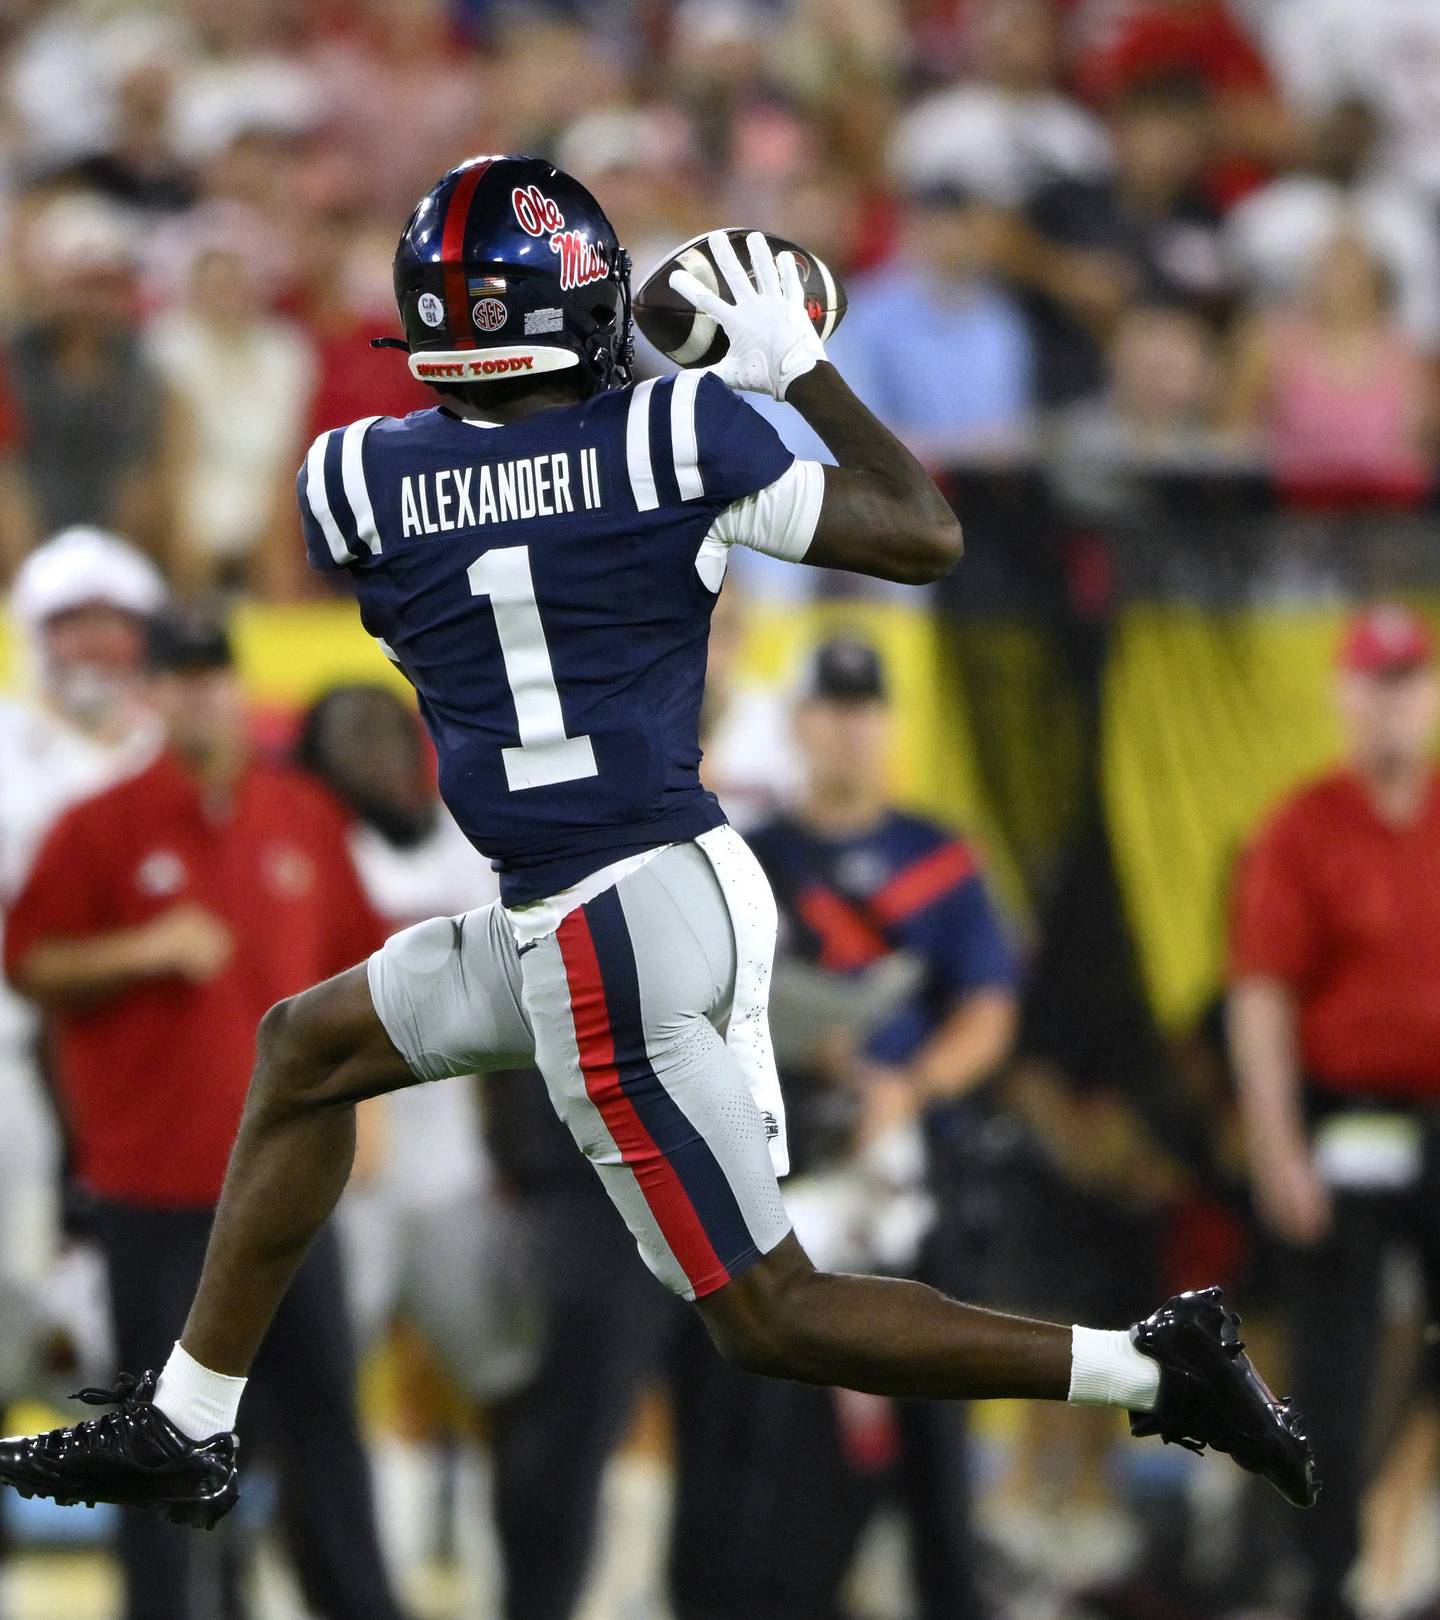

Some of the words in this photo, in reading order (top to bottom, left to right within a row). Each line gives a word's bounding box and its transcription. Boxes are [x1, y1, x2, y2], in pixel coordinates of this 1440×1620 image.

[512, 185, 565, 237] Ole
[550, 229, 610, 291] Miss
[421, 297, 437, 310] CA
[425, 311, 439, 323] 91
[474, 301, 505, 329] SEC
[469, 355, 534, 376] TODDY
[401, 452, 575, 538] ALEXANDER
[580, 447, 602, 510] II
[466, 545, 598, 792] 1
